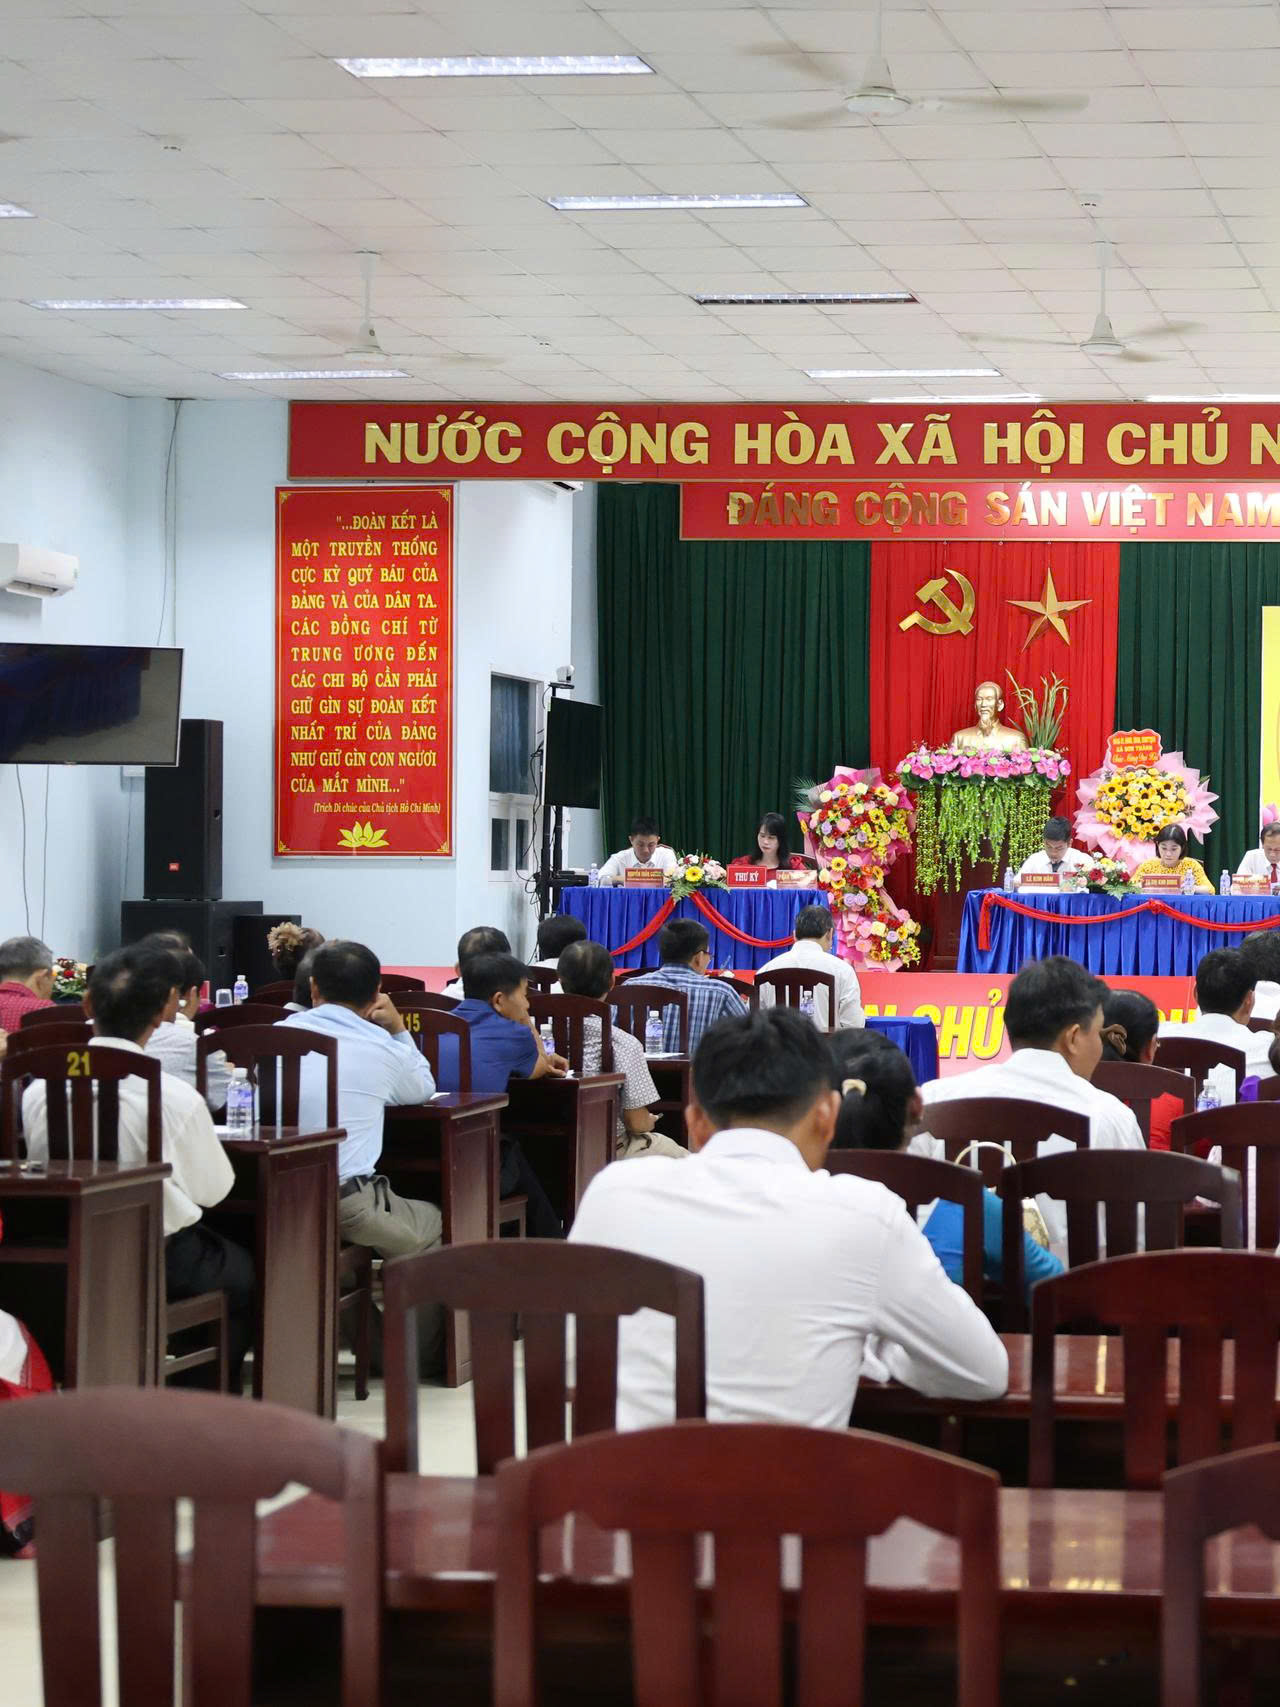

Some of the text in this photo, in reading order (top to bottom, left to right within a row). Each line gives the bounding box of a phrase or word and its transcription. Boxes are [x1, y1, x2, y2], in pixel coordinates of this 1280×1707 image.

[365, 411, 522, 464] NƯỚC
[547, 411, 709, 474] CỘNG
[734, 411, 855, 465] HÒA
[874, 413, 958, 465] XÃ
[983, 408, 1084, 474] HỘI
[1106, 408, 1228, 465] CHỦ
[392, 509, 416, 529] KẾT
[422, 511, 438, 529] LÀ
[855, 483, 967, 533] CỘNG
[1081, 484, 1175, 534] VIỆT
[291, 535, 438, 560] MỘT TRUYỀN THỐNG
[291, 562, 438, 586] CỰC KỲ QUÝ BÁU CỦA
[291, 589, 437, 608] ĐẢNG VÀ CỦA DÂN TA.
[291, 614, 438, 635] CÁC ĐỒNG CHÍ TỪ
[291, 641, 437, 661] TRUNG ƯƠNG ĐẾN
[291, 666, 437, 690] CÁC CHI BỘ CẦN PHẢI
[291, 693, 437, 717] GIỮ GÌN SỰ ĐOÀN KẾT
[291, 720, 437, 740] NHẤT TRÍ CỦA ĐẢNG
[291, 750, 316, 766] NHƯ
[320, 749, 342, 766] GIỮ
[345, 748, 366, 766] GÌN
[370, 752, 394, 766] CON
[291, 774, 316, 792] CỦA
[323, 772, 349, 792] MẮT
[735, 872, 759, 882] THƯ KÝ
[67, 1052, 90, 1076] 21
